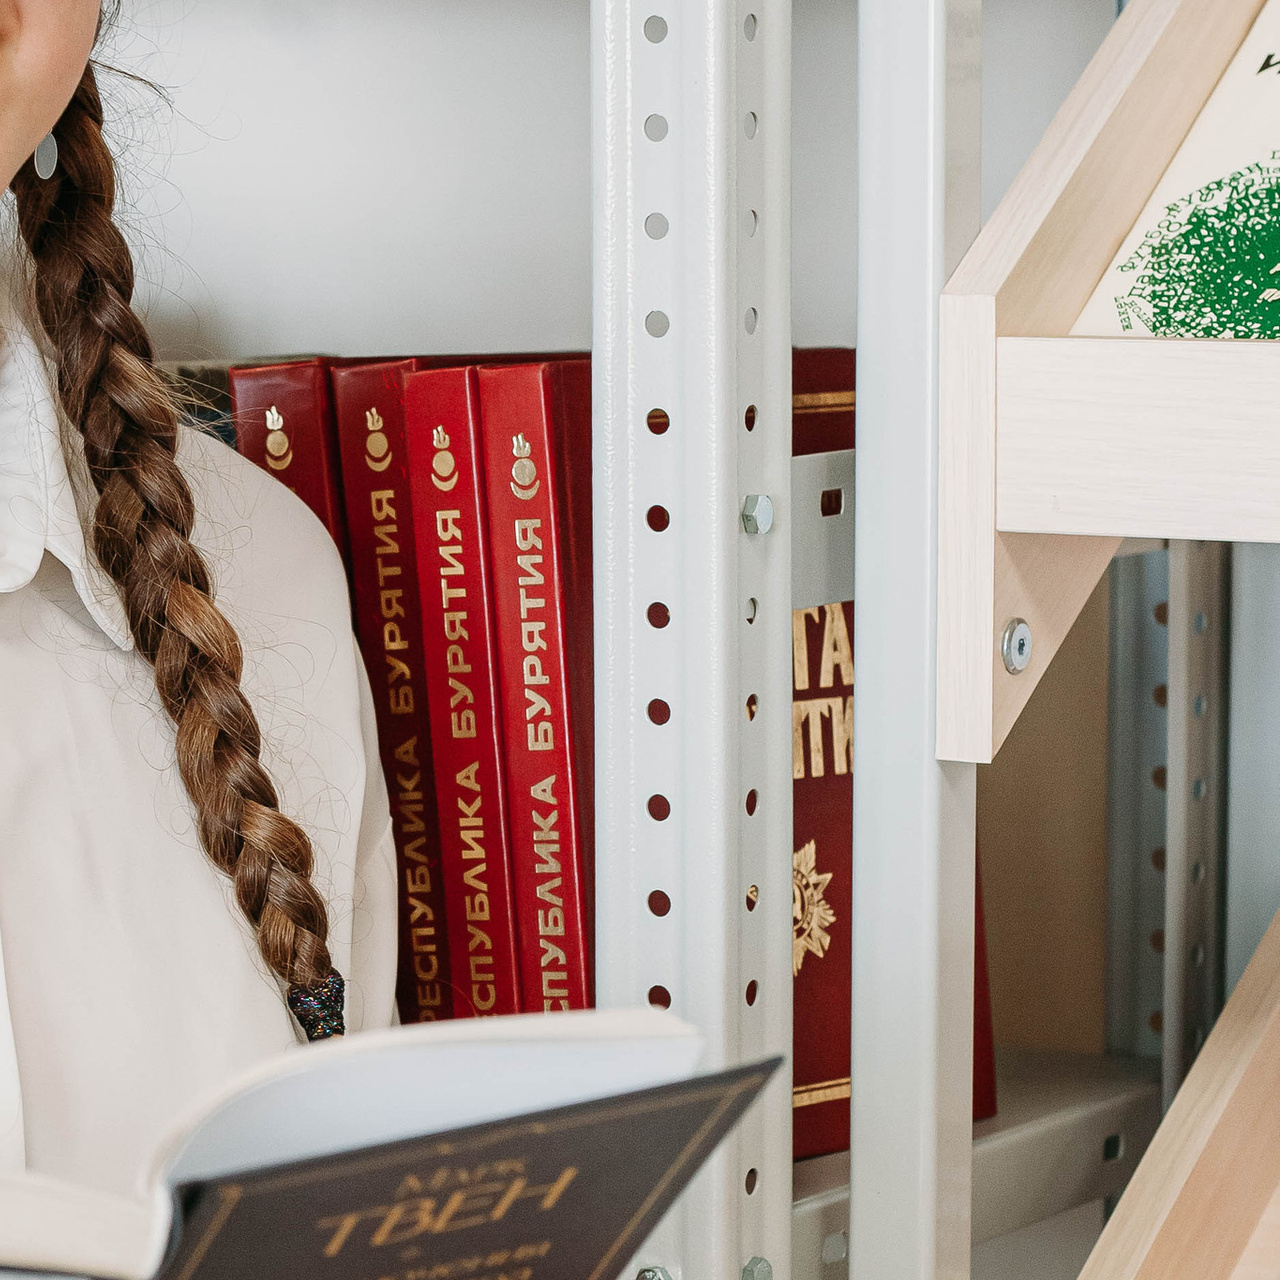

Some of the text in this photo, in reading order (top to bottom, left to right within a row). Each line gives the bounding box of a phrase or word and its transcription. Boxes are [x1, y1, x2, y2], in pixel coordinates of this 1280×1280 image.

[371, 490, 414, 716] БУРЯТИЯ
[515, 519, 554, 752] БУРЯТИЯ
[436, 509, 495, 1018] СПУБЛИКА БУРЯТИЯ
[317, 1166, 579, 1257] ТВЕН
